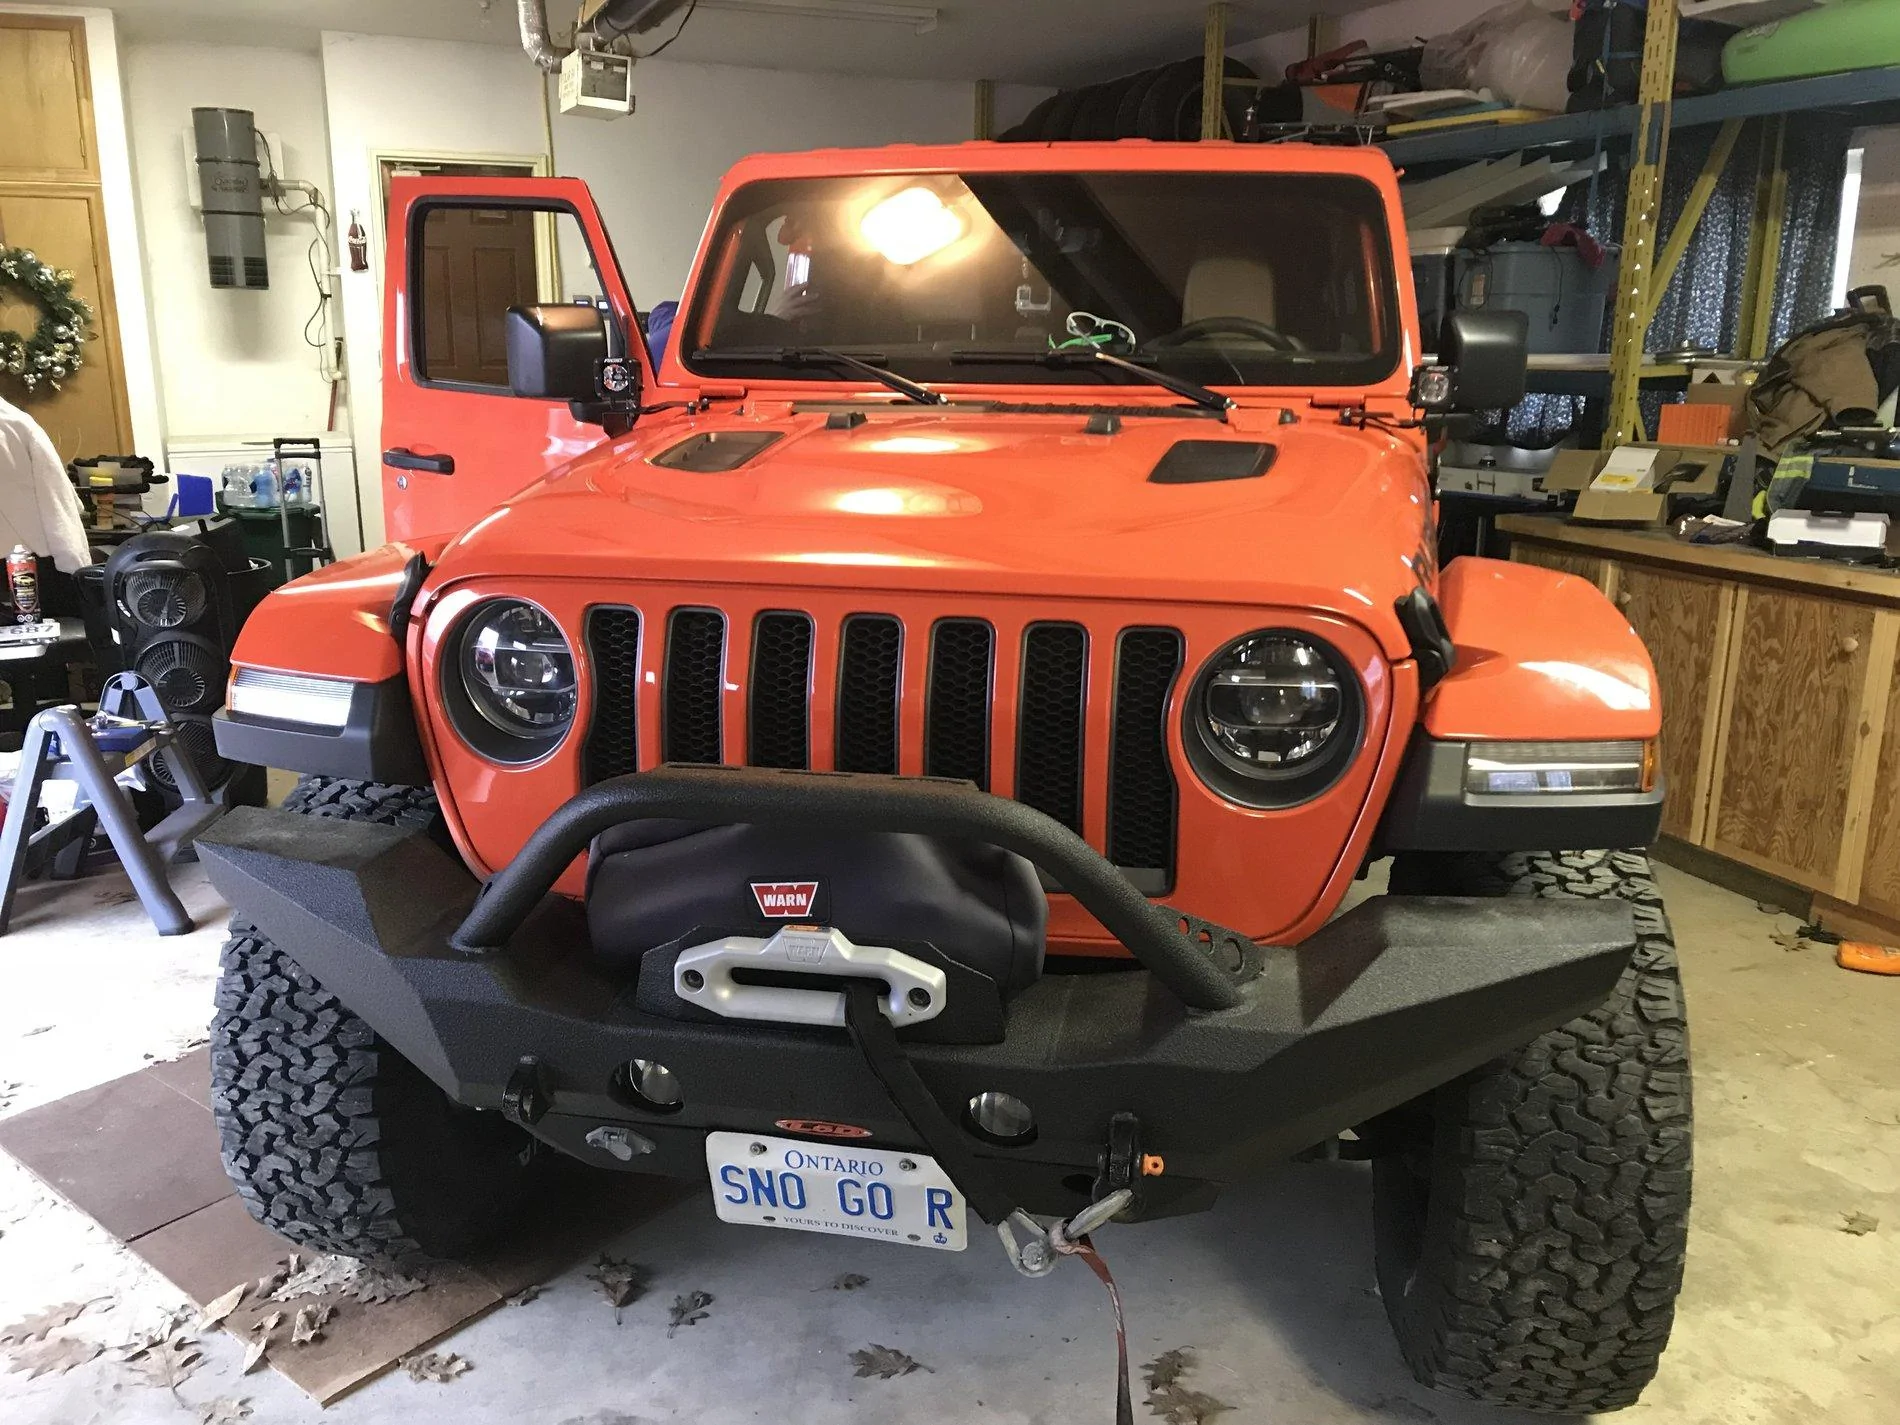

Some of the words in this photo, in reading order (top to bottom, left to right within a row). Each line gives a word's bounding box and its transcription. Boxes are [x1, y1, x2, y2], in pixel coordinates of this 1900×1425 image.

[763, 893, 807, 907] WARN
[784, 1150, 884, 1176] ONTARIO
[926, 1187, 954, 1230] R
[783, 1216, 821, 1227] YOURS
[824, 1220, 839, 1229] TO
[841, 1222, 899, 1237] DISCOVER
